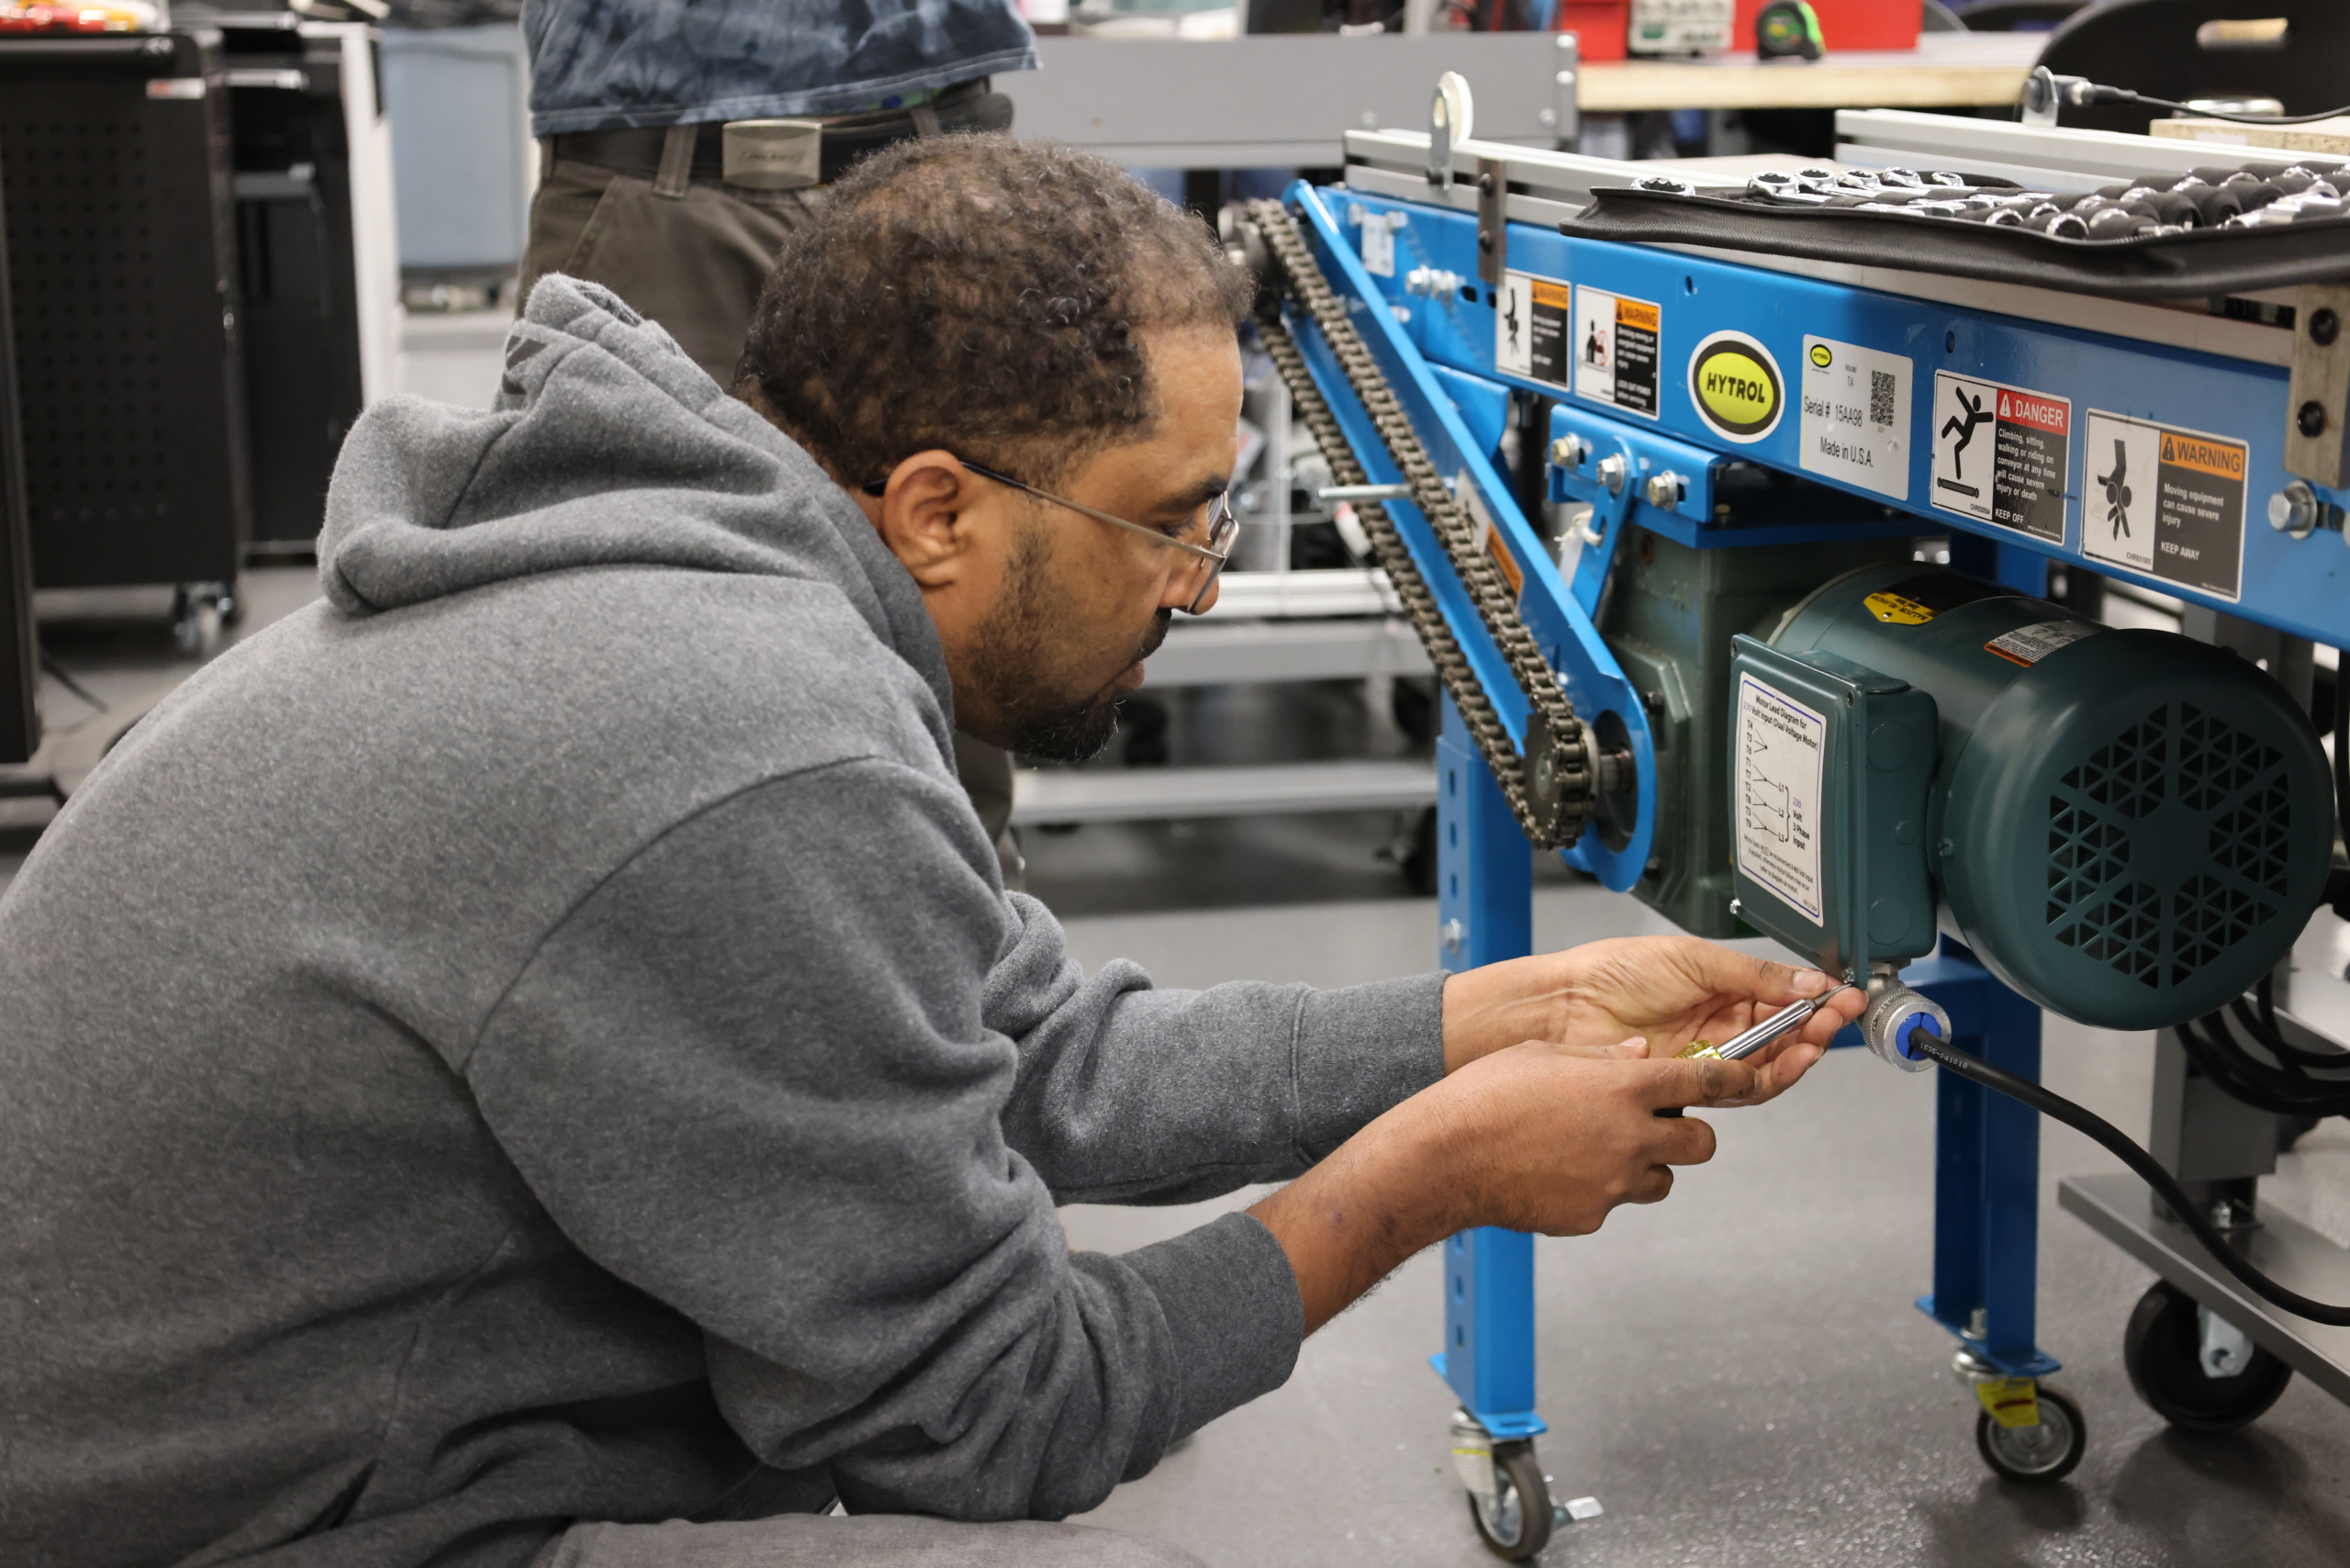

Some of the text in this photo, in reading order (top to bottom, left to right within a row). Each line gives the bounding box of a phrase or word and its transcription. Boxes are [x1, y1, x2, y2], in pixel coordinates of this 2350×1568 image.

[1707, 372, 1765, 404] HYTROL
[1847, 376, 1854, 387] TA
[1804, 396, 1863, 427] Serial # 15AA98
[2015, 400, 2063, 428] DANGER
[1820, 436, 1874, 467] Made in U.S.A.
[1998, 443, 2019, 457] walking
[2028, 450, 2045, 464] riding
[2177, 441, 2241, 473] WARNING
[1997, 457, 2056, 478] conveyor at any time
[1997, 469, 2044, 489] will cause severe
[1996, 483, 2012, 495] injury
[2021, 489, 2037, 501] death
[2164, 483, 2224, 507] Moving equipment
[1995, 508, 2024, 524] KEEP OFF
[2163, 499, 2219, 521] can cause severe
[2163, 512, 2181, 528] injury
[2161, 541, 2200, 560] KEEP AWAY
[1756, 694, 1769, 709] Motor
[1769, 702, 1780, 715] Lead
[1780, 708, 1799, 726] Diagram
[1747, 719, 1753, 730] T4
[1752, 706, 1760, 717] Volt
[1761, 711, 1772, 725] Input
[1785, 724, 1802, 742] Voltage
[1802, 734, 1818, 751] Motor)
[1747, 732, 1752, 742] T5
[1746, 744, 1752, 754] T6
[1746, 757, 1751, 767] T1
[1746, 769, 1751, 779] T7
[1745, 781, 1751, 792] T2
[1779, 782, 1784, 792] L1
[1793, 797, 1802, 808] 230
[1746, 806, 1751, 816] T3
[1779, 807, 1784, 818] L2
[1793, 809, 1802, 822] Volt
[1746, 818, 1751, 828] T9
[1779, 832, 1784, 843] L3
[1796, 824, 1810, 840] Phase
[1793, 835, 1805, 850] Input
